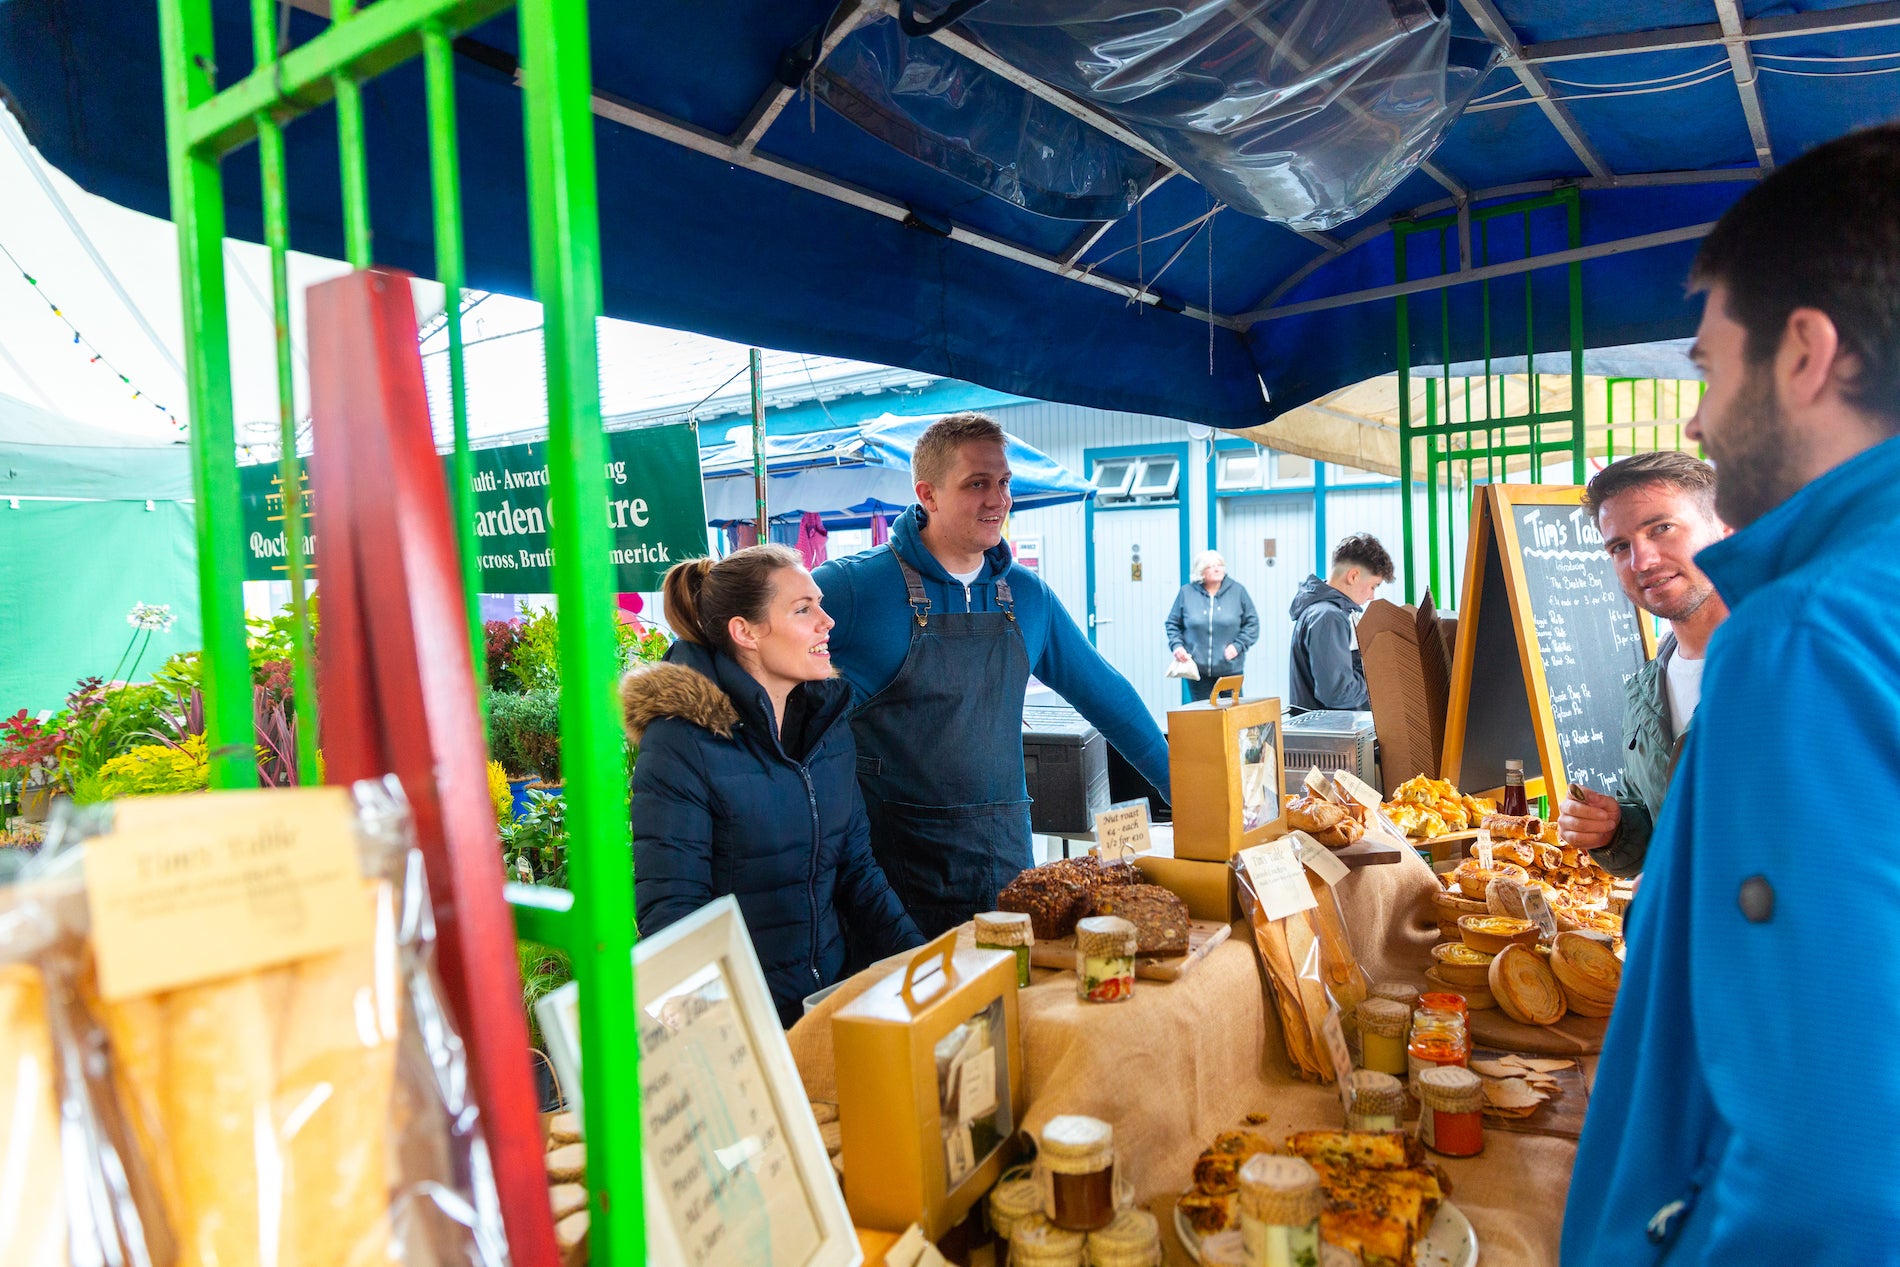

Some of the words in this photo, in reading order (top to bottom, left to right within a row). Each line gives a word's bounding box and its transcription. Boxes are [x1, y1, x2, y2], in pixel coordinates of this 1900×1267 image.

[471, 464, 551, 492] ulti-Award
[473, 500, 546, 537] arden
[1523, 508, 1568, 548] Tim's
[1569, 507, 1605, 546] Tab
[475, 553, 519, 573] ycross,
[609, 542, 671, 565] merick
[1584, 594, 1590, 606] 3
[1602, 591, 1616, 603] €10
[1581, 682, 1592, 698] Pie
[1571, 701, 1584, 716] Pie
[1567, 762, 1589, 786] Enjoy
[1597, 772, 1618, 792] Thank
[1103, 814, 1119, 826] Nut
[1120, 808, 1140, 820] roast
[1122, 819, 1140, 832] each
[1119, 834, 1130, 849] for
[1131, 832, 1145, 842] €10
